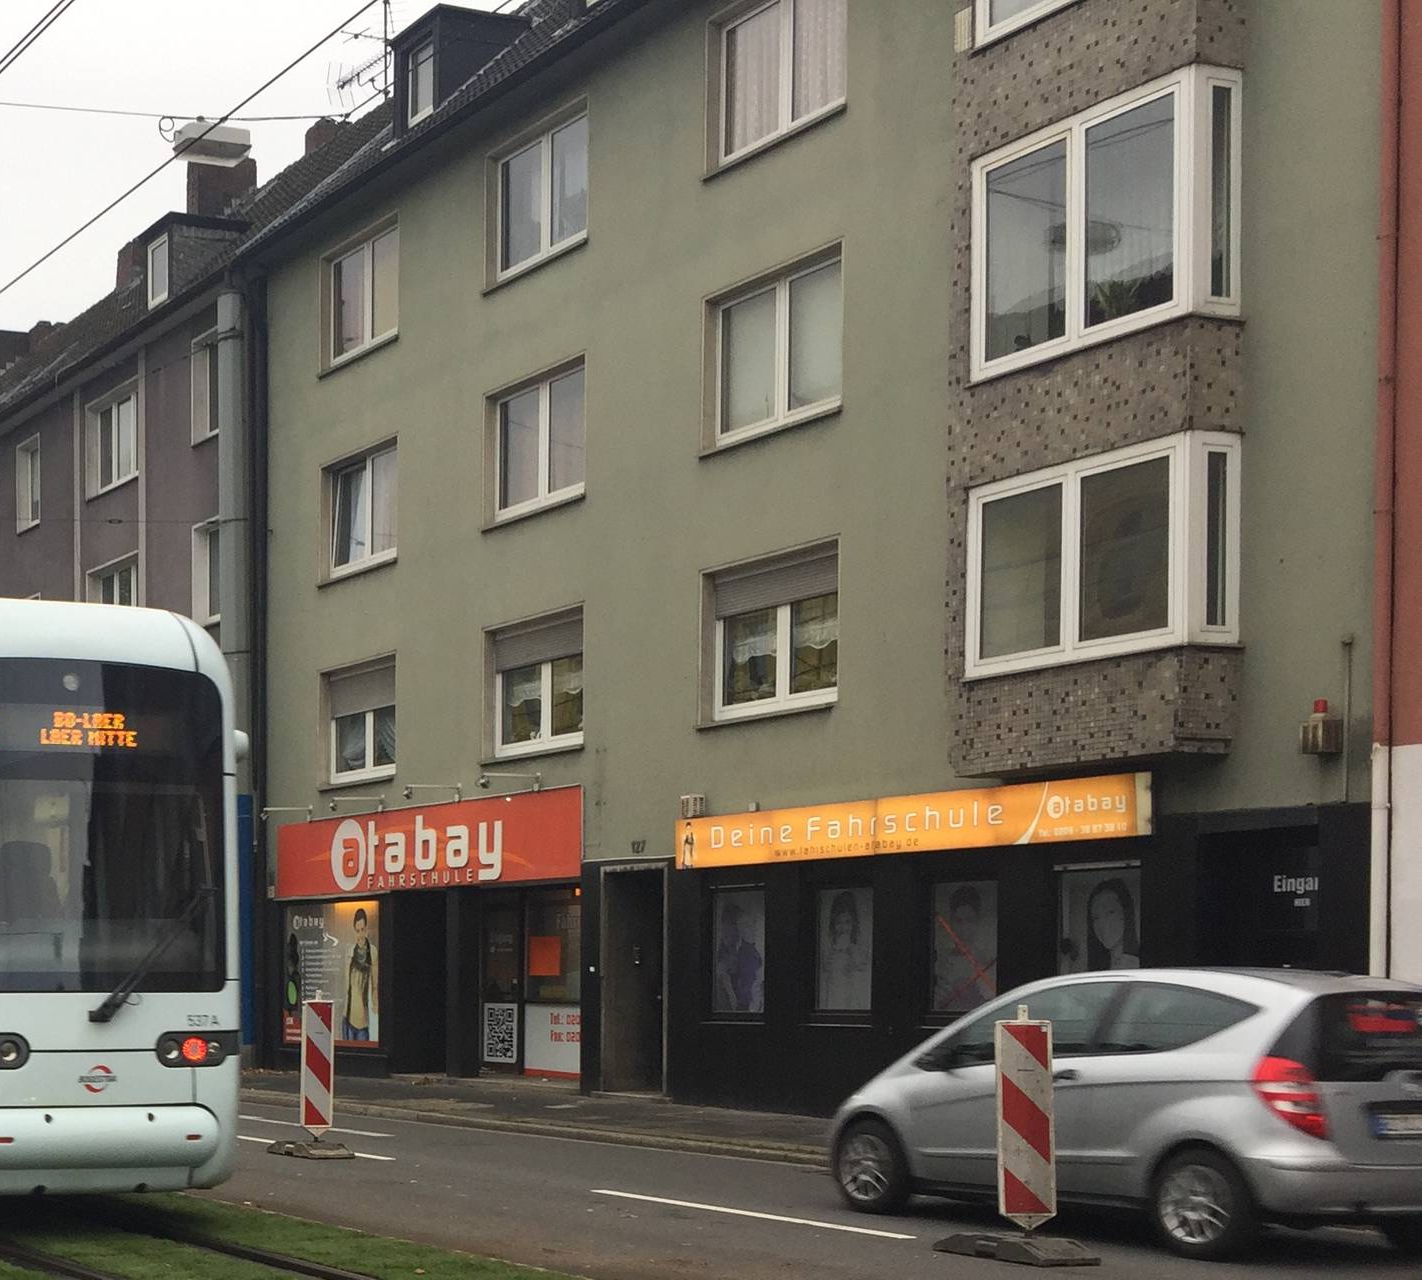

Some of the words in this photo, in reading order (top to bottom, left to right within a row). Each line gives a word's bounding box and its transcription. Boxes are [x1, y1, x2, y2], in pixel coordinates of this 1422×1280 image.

[1047, 794, 1127, 819] atabay
[710, 824, 793, 849] Deine
[806, 801, 1003, 841] Fahrschule
[331, 815, 503, 891] atabay
[367, 868, 474, 890] FAHRSCHULE
[186, 1014, 210, 1028] 537
